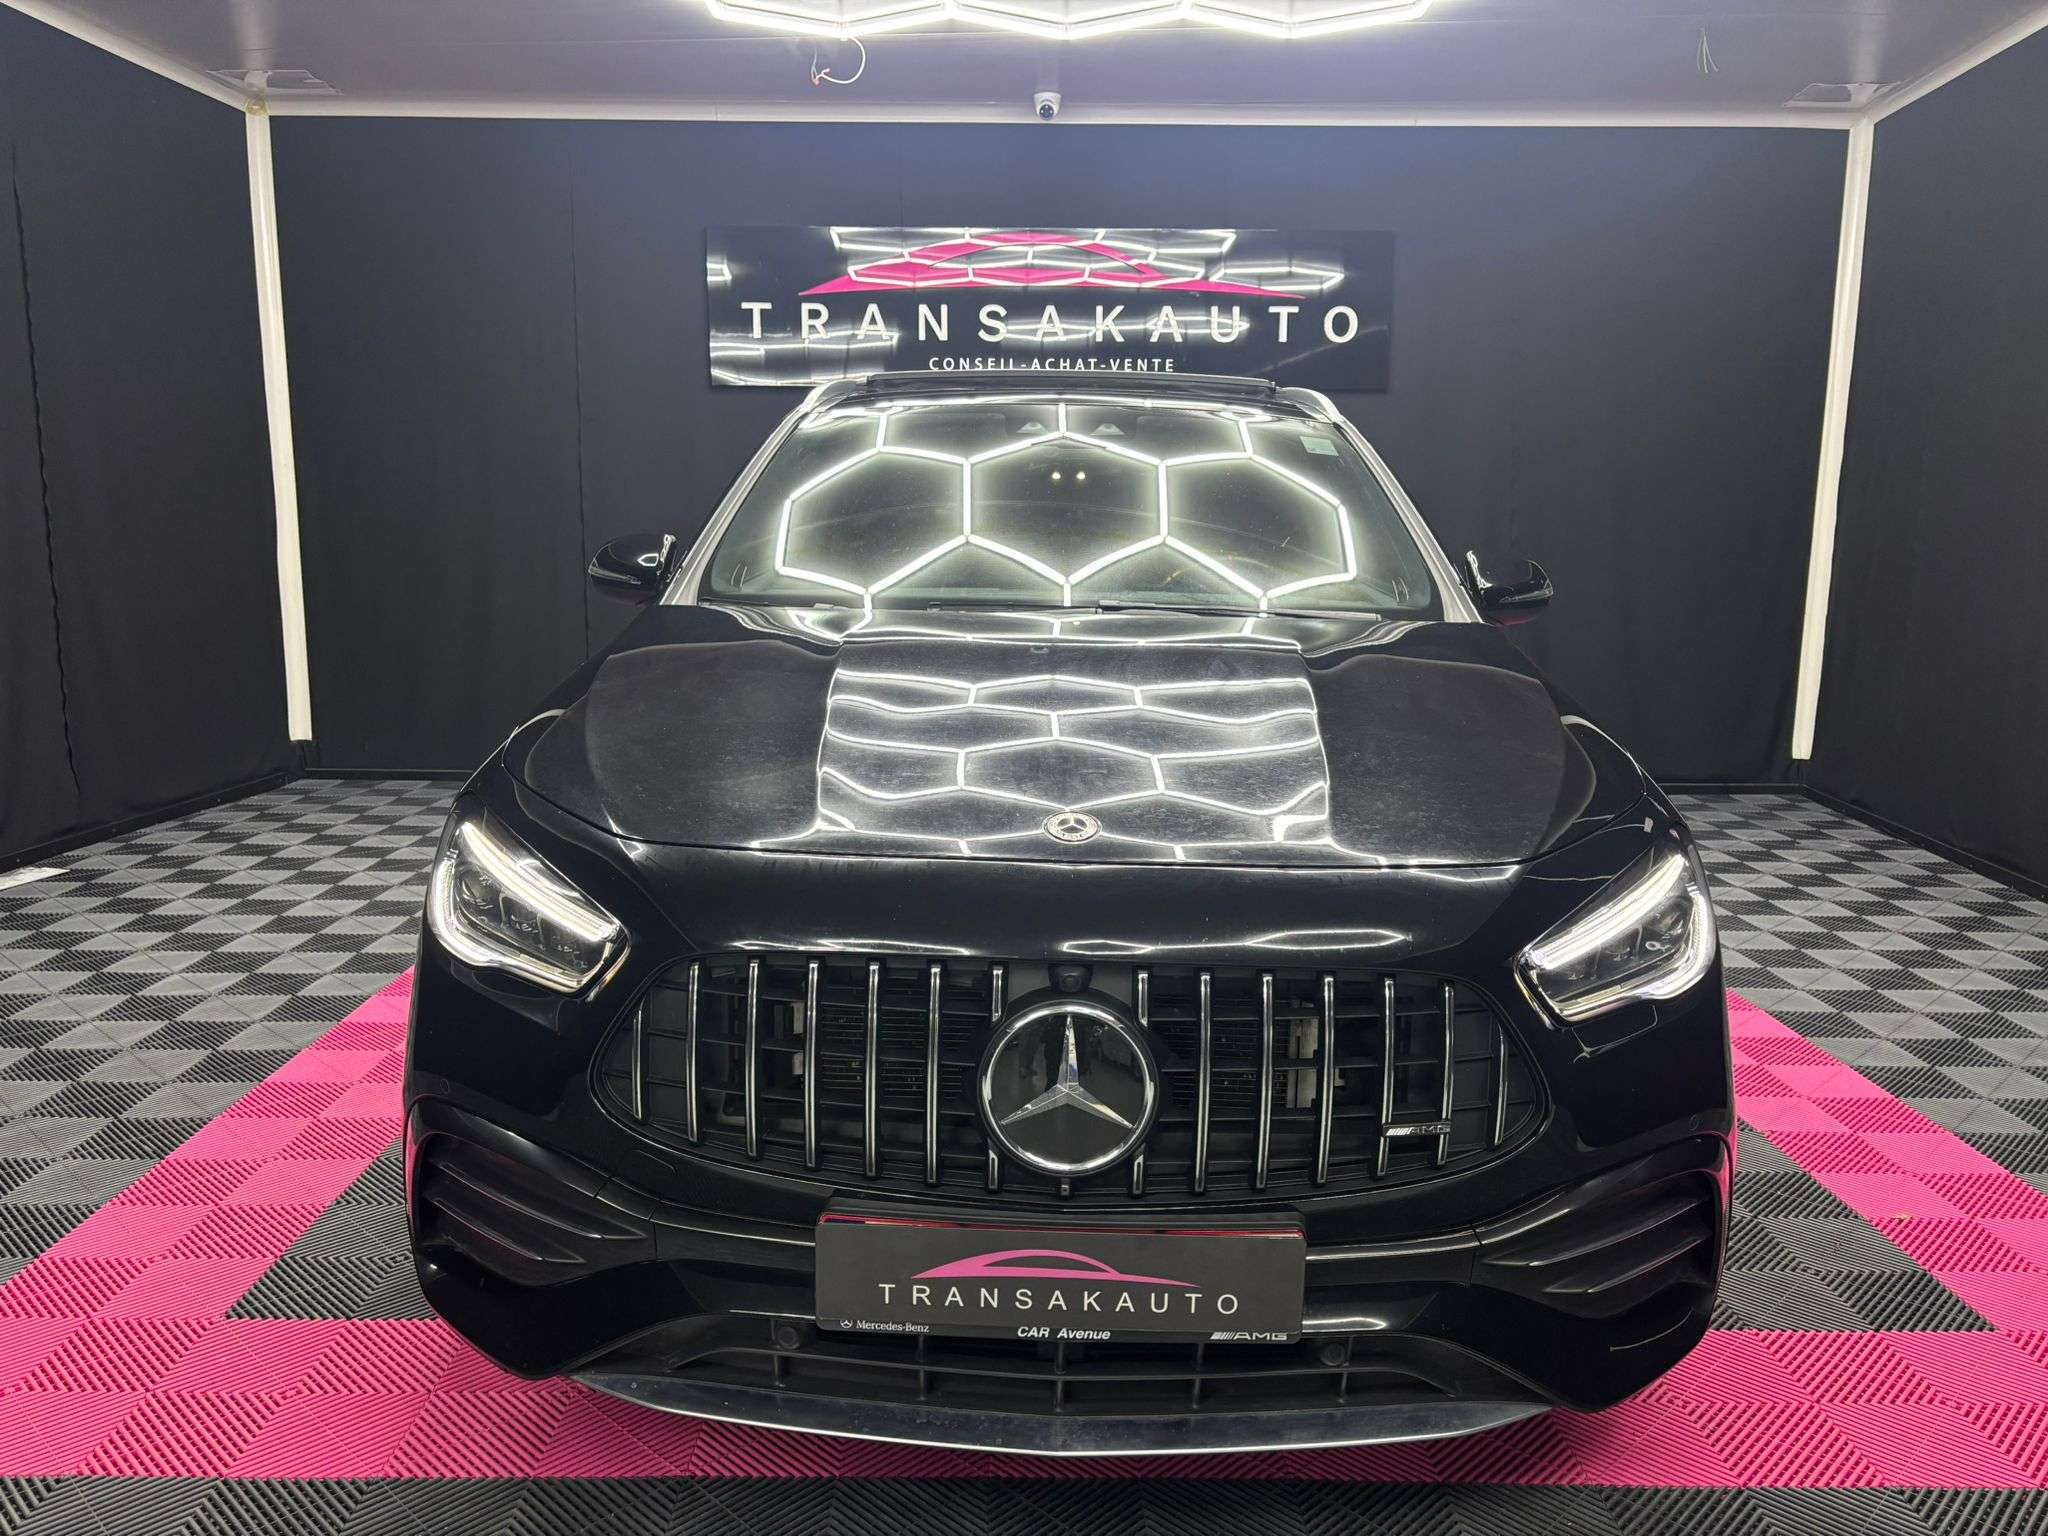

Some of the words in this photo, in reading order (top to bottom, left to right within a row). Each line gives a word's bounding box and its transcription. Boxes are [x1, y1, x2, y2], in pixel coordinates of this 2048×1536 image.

[741, 302, 1359, 343] TRANSAKAUTO
[878, 1282, 1240, 1315] TRANSAKAUTO
[856, 1320, 930, 1334] Mercedes-Benz
[1017, 1326, 1050, 1339] CAR
[1057, 1328, 1112, 1341] Avenue
[1233, 1331, 1288, 1341] AMG
